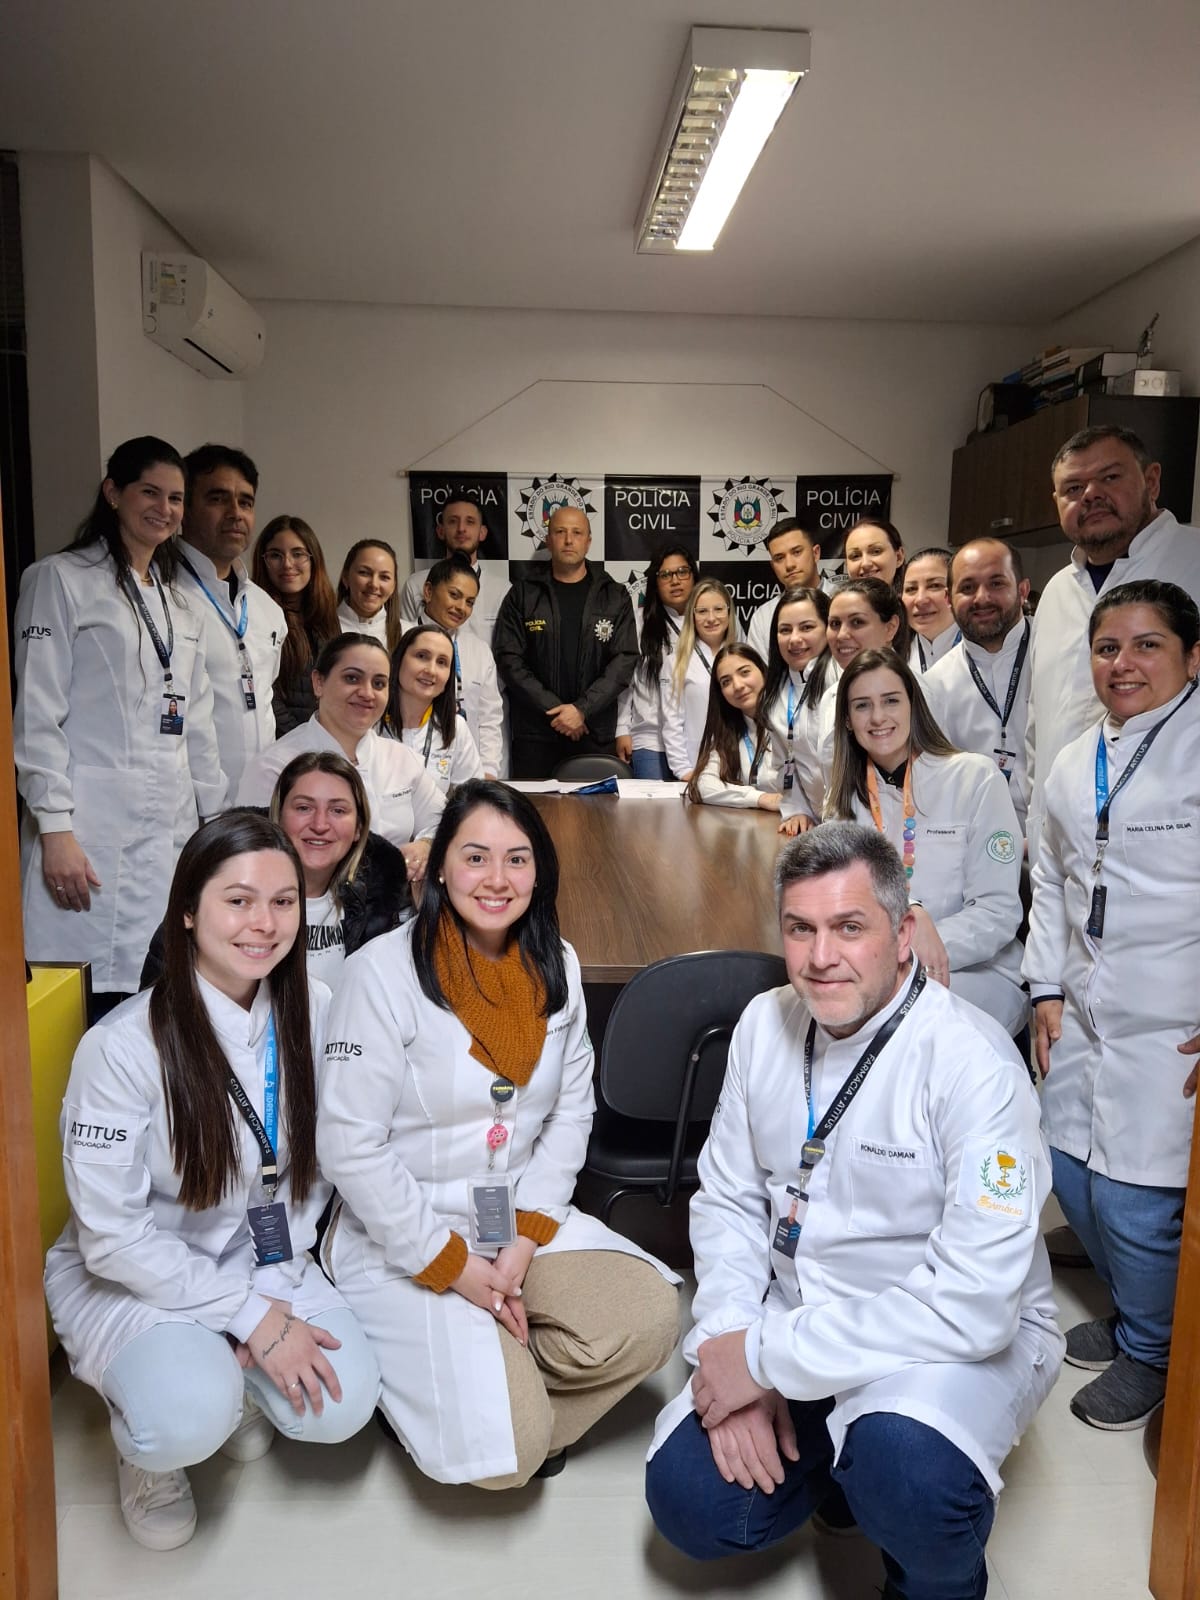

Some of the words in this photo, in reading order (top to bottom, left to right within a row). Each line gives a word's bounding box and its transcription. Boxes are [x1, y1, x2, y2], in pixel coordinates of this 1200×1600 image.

[421, 485, 498, 506] POIA
[555, 483, 578, 497] GRANDE
[615, 488, 691, 508] POLÍCIA
[748, 484, 770, 497] GRANDE
[806, 486, 881, 506] POLÍCIA
[628, 513, 676, 530] CIVIL
[724, 580, 782, 600] OLÍCIA
[1130, 743, 1148, 769] ATITUS
[325, 1041, 362, 1056] ATITUS
[824, 1099, 846, 1130] ATITUS
[71, 1121, 128, 1142] ATITUS
[73, 1140, 112, 1150] EDUCAÇÃO
[860, 1144, 886, 1156] RONALDO
